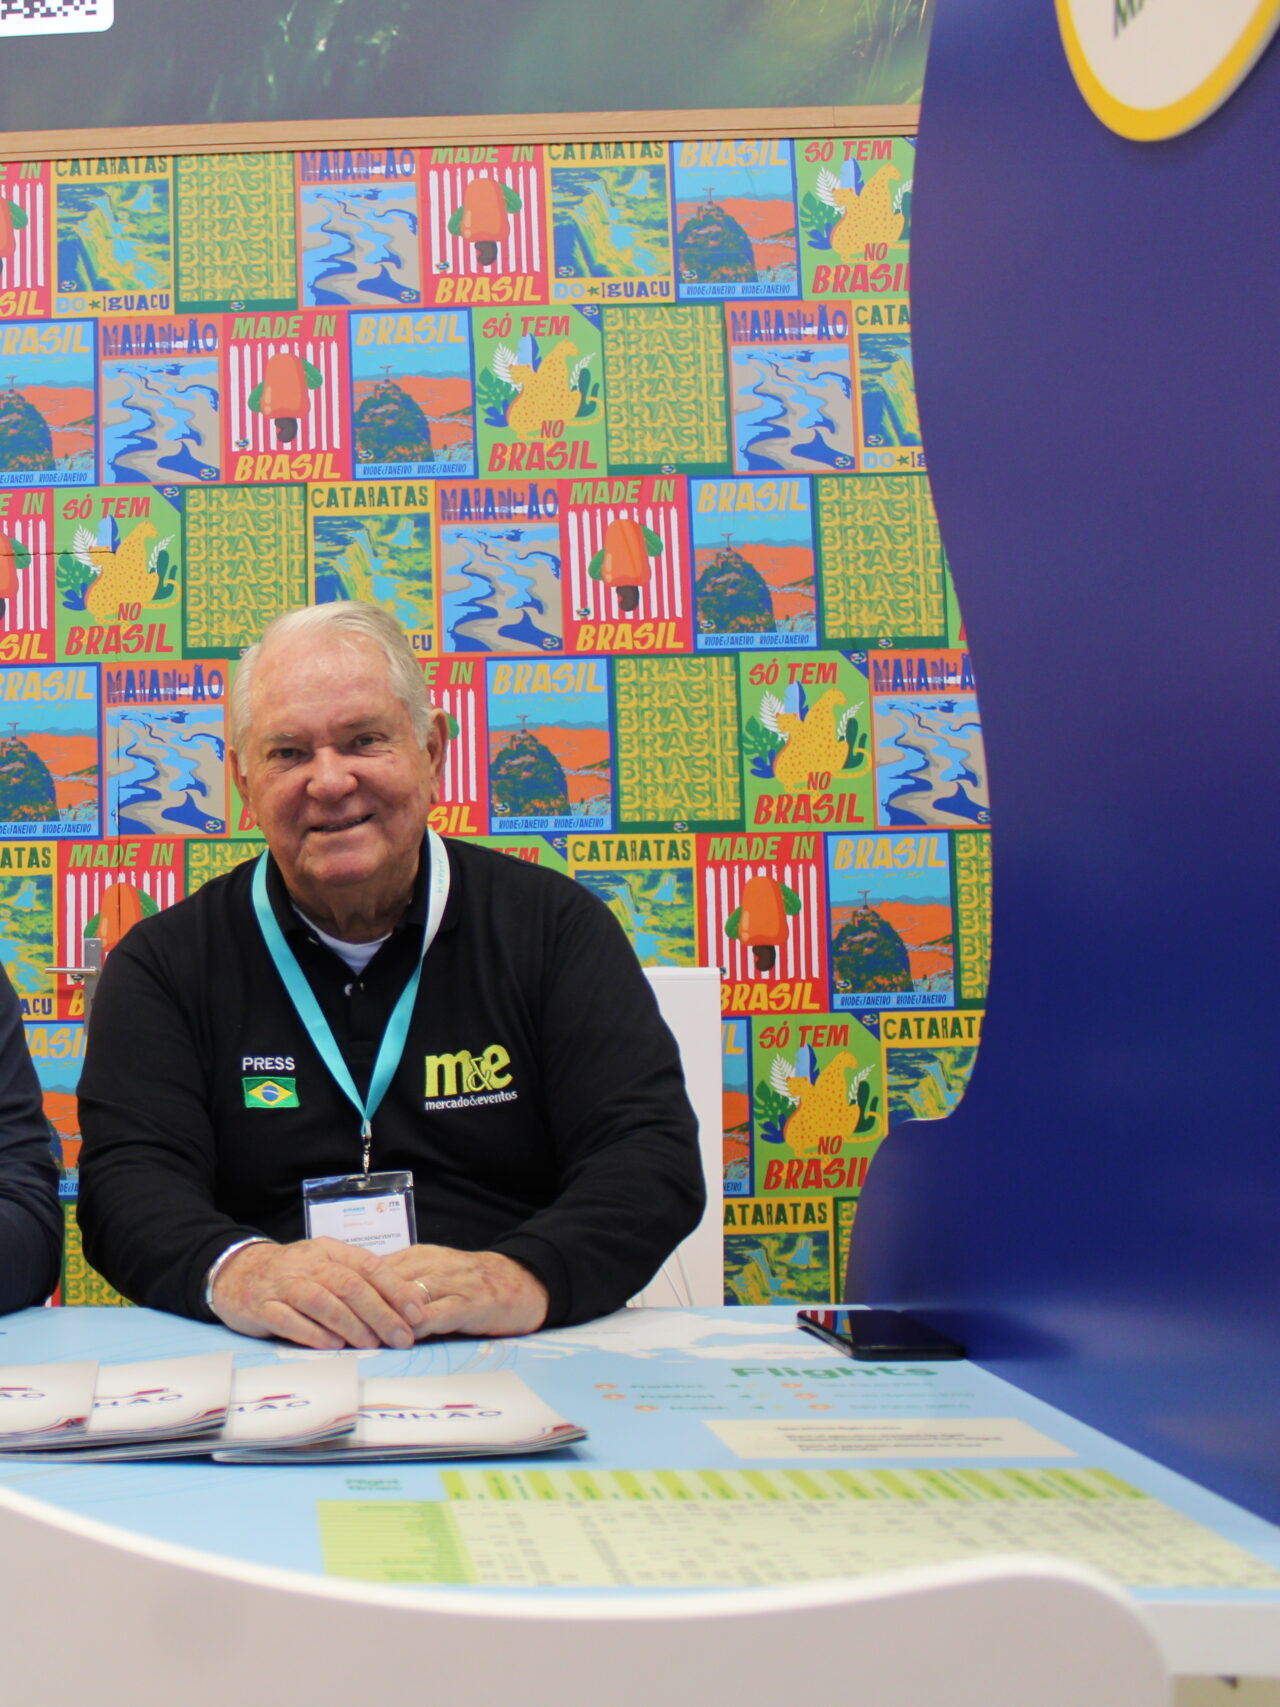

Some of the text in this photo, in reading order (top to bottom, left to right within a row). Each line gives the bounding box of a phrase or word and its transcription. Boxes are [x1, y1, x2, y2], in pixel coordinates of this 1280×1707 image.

[431, 143, 534, 164] MADE IN
[549, 142, 663, 160] CATARATAS
[680, 139, 788, 168] BRASIL
[805, 139, 893, 161] SÓ TEM
[20, 163, 42, 180] IN
[56, 156, 168, 176] CATARATAS
[178, 154, 293, 173] BRASIL
[179, 171, 293, 195] BRASIL
[864, 242, 887, 261] NO
[435, 277, 542, 303] BRASIL
[554, 282, 584, 299] DO
[813, 264, 910, 294] BRASI
[56, 296, 85, 314] DO
[233, 315, 337, 338] MADE IN
[357, 313, 466, 345] BRASIL
[483, 313, 571, 338] SÓ TEM
[604, 306, 724, 330] BRASIL
[604, 329, 725, 355] BRASIL
[541, 420, 564, 439] NO
[234, 452, 341, 482] BRASIL
[489, 440, 598, 471] BRASIL
[864, 453, 894, 468] DO
[187, 488, 304, 512] BRASIL
[311, 485, 428, 509] CATARATAS
[568, 480, 675, 504] MADE IN
[697, 481, 807, 512] BRASIL
[819, 476, 931, 500] BRASIL
[21, 493, 45, 515] IN
[64, 494, 150, 520] SÓ TEM
[820, 500, 938, 526] BRASIL
[187, 511, 305, 536] BRASIL
[822, 524, 941, 552] BRASIL
[117, 602, 141, 621] NO
[65, 624, 174, 656] BRASIL
[577, 623, 684, 651] BRASIL
[450, 663, 474, 684] IN
[492, 663, 605, 694] BRASIL
[615, 657, 736, 682] BRASIL
[749, 659, 838, 685] SÓ TEM
[873, 652, 975, 691] MARANHÃ
[616, 682, 737, 708] BRASIL
[618, 706, 738, 732] BRASIL
[807, 772, 831, 790] NO
[754, 794, 865, 825] BRASIL
[68, 844, 140, 867] MADE
[151, 842, 174, 864] IN
[572, 838, 692, 861] CATARATAS
[707, 835, 814, 861] MADE IN
[834, 836, 946, 869] BRASIL
[759, 1021, 790, 1048] SÓ
[798, 1025, 849, 1047] TEM
[242, 1057, 295, 1071] PRESS
[425, 1044, 513, 1098] m&e
[425, 1090, 518, 1111] mercado&eventos
[818, 1136, 842, 1155] NO
[765, 1157, 867, 1189] BRASI
[724, 1202, 827, 1226] ATARATAS
[731, 1367, 939, 1380] Flights
